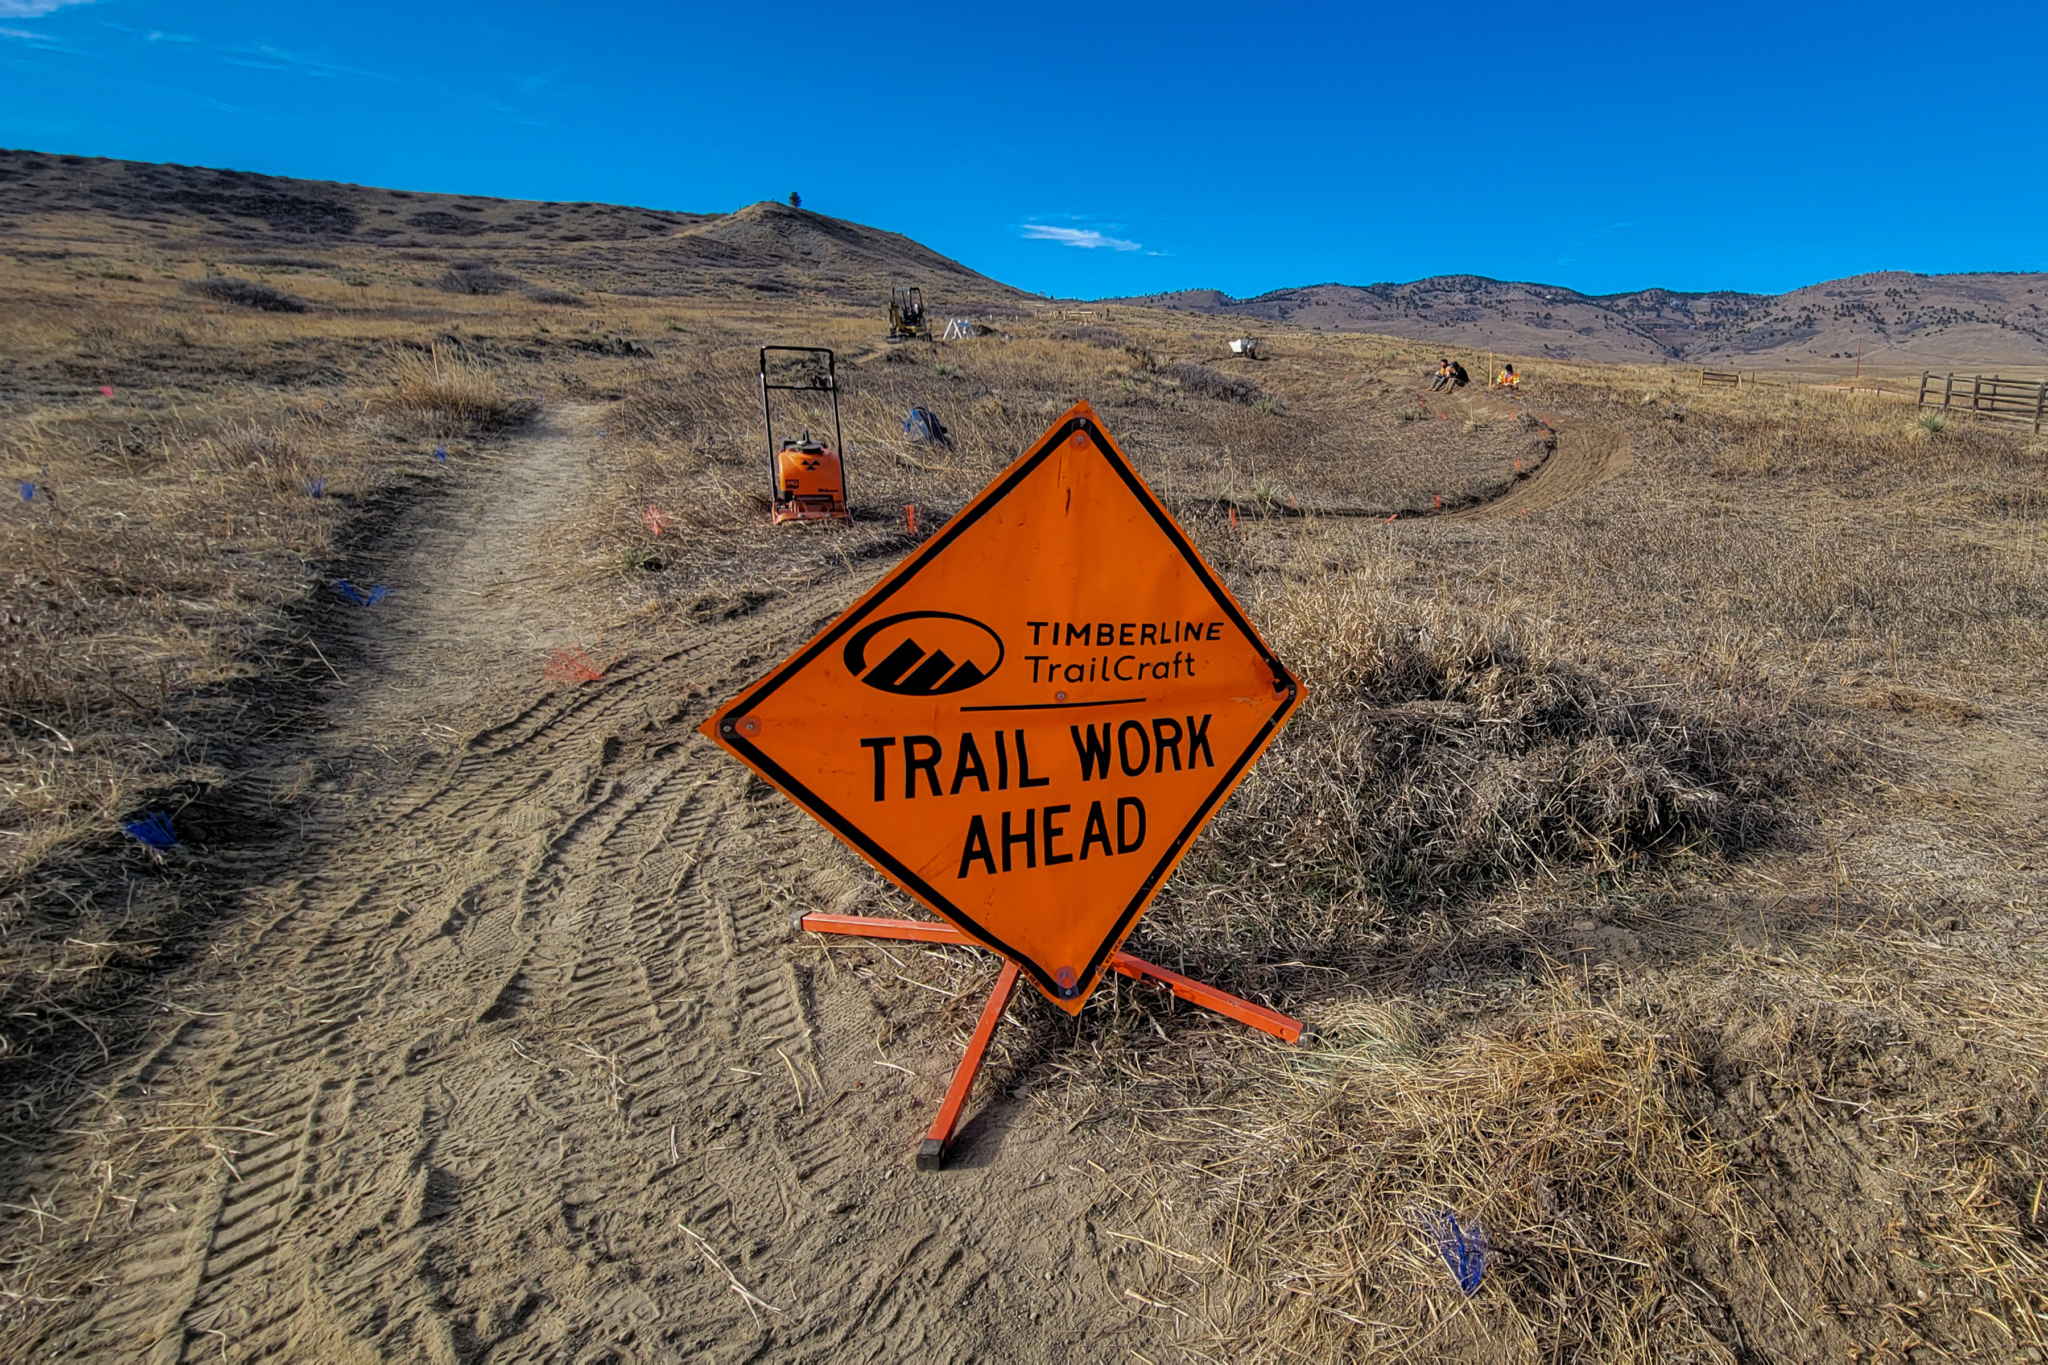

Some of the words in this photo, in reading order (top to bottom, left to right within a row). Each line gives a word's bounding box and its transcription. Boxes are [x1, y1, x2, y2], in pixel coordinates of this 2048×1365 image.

[1027, 621, 1224, 646] TIMBERLINE
[1025, 651, 1195, 683] TrailCraft
[861, 729, 1049, 801] TRAIL
[1071, 714, 1214, 781] WORK
[958, 797, 1146, 878] AHEAD
